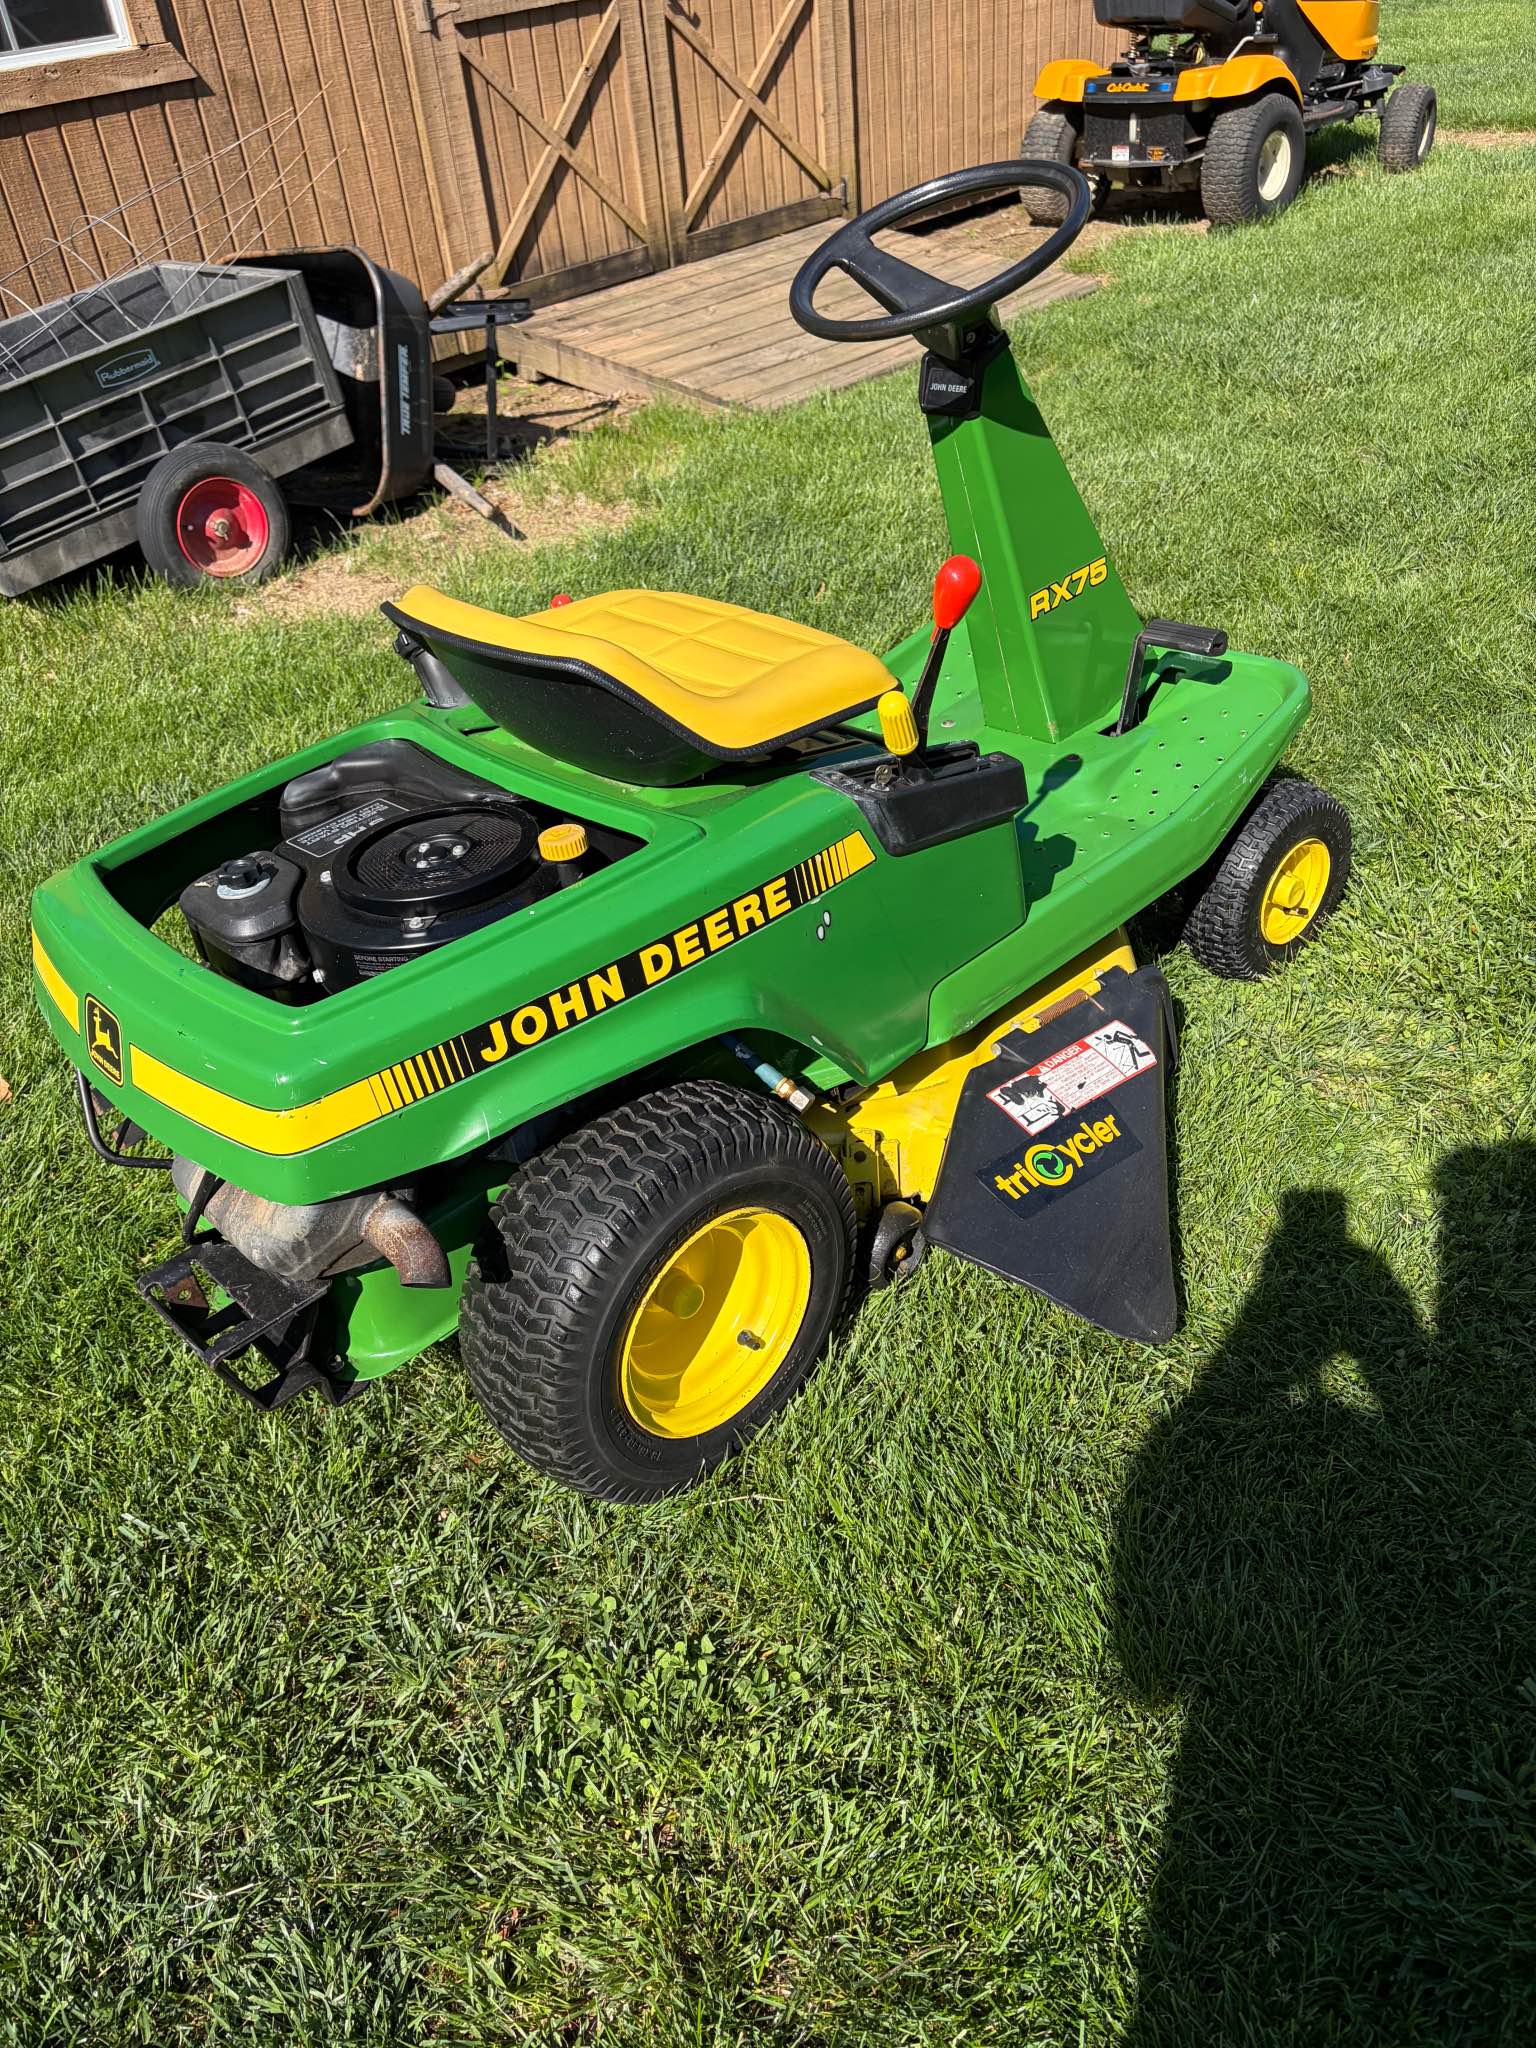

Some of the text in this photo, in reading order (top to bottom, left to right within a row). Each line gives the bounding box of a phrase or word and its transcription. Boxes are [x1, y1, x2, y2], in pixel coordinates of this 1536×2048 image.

[930, 383, 968, 393] JOHN DEERE
[480, 876, 792, 1063] JOHN DEERE
[1047, 1045, 1083, 1069] DANGER
[994, 1114, 1122, 1200] triCycler
